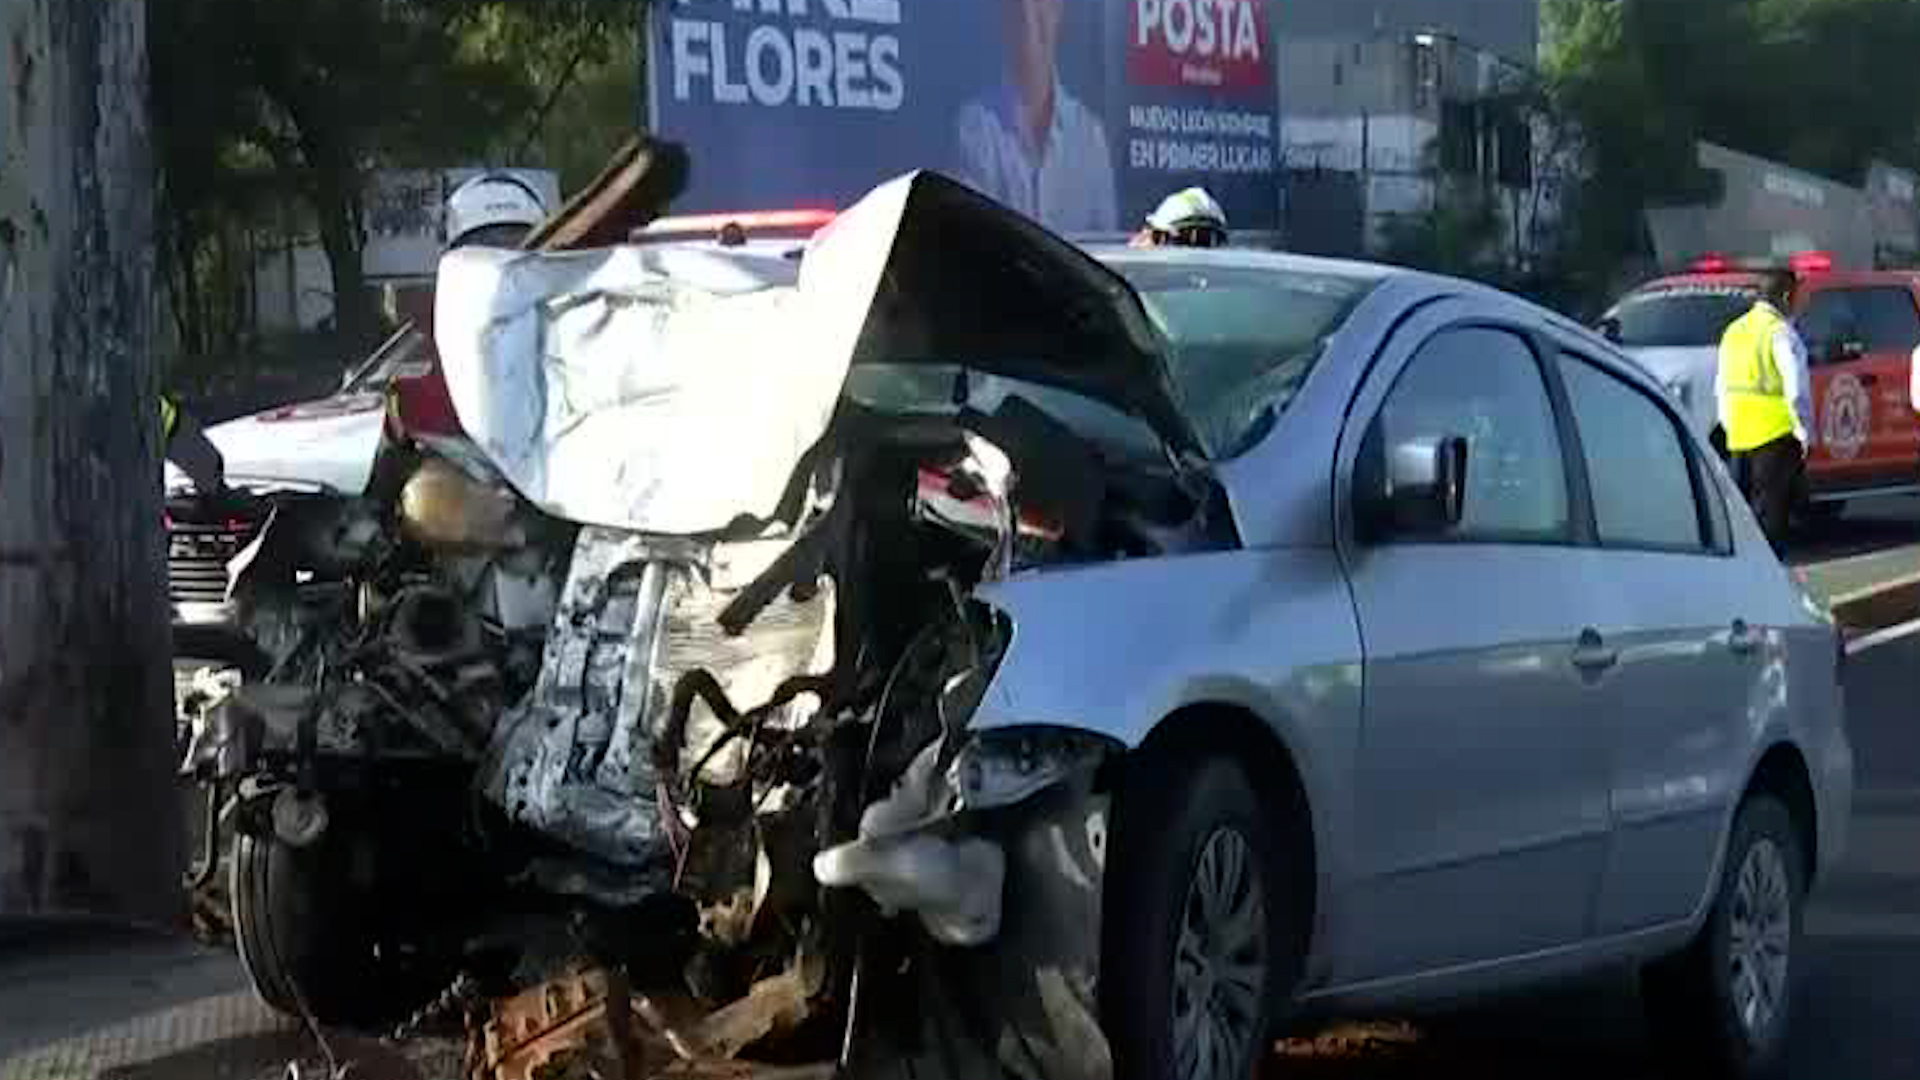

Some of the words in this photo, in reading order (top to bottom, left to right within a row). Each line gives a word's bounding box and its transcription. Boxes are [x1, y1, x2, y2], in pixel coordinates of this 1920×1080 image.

[1138, 0, 1259, 60] POSTA
[672, 19, 903, 110] FLORES
[1130, 105, 1179, 132] NUEVO
[1130, 139, 1155, 168] EN
[1158, 141, 1218, 170] PRIMER
[1221, 146, 1272, 173] LUGAR
